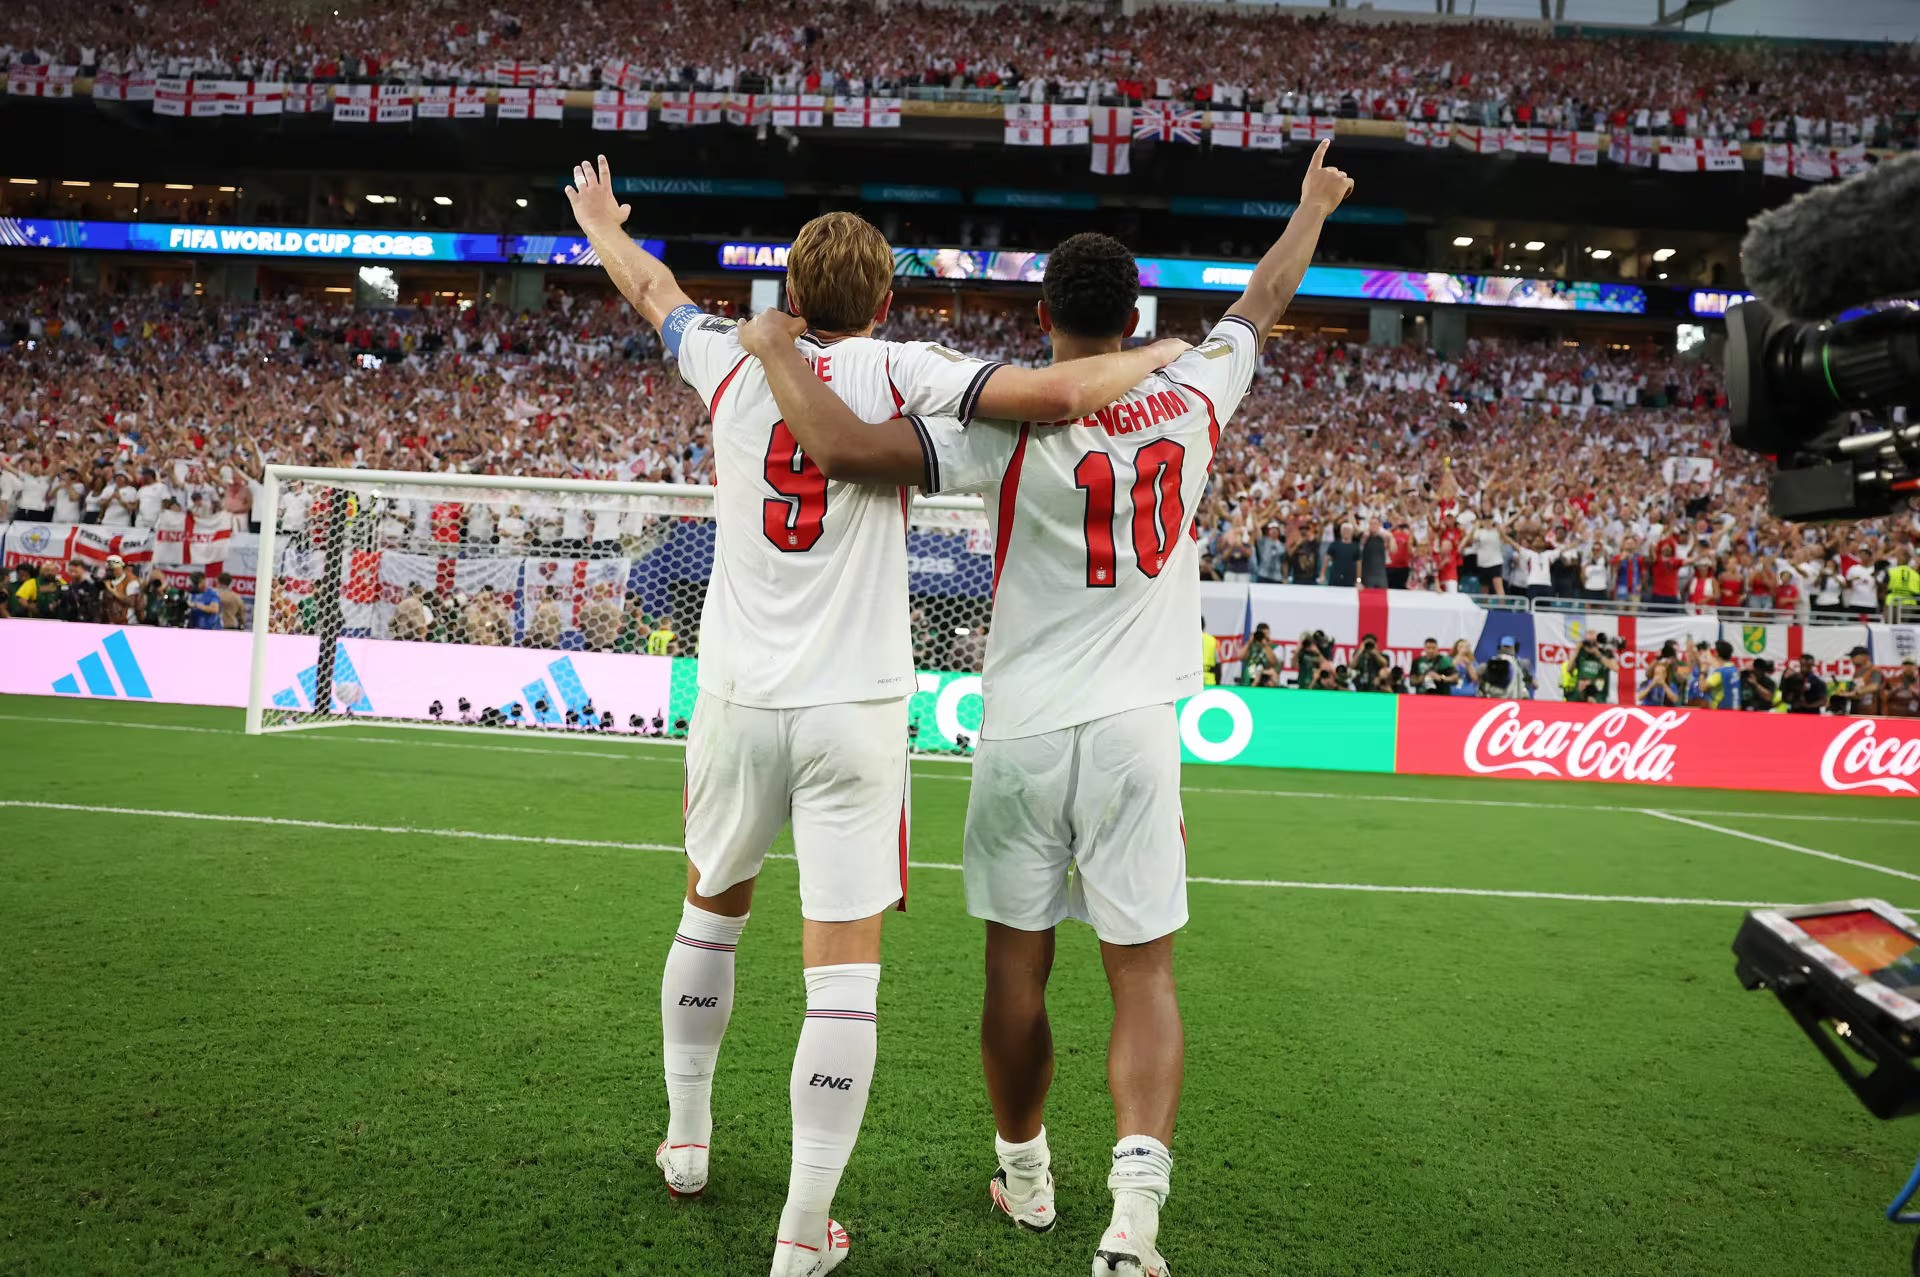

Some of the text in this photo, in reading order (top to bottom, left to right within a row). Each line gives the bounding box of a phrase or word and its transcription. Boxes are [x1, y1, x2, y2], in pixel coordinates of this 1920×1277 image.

[625, 179, 713, 194] ENDZONE
[1243, 201, 1294, 217] ENDZ
[169, 228, 433, 256] FIFA WORLD CUP 2026
[723, 245, 791, 267] MIAM
[1037, 390, 1189, 437] NGHAM
[763, 418, 829, 553] 9
[1073, 437, 1186, 588] 10
[1540, 645, 1649, 669] CACK
[1463, 701, 1691, 782] Coca-Cola
[678, 994, 719, 1008] ENG
[808, 1073, 853, 1091] ENG
